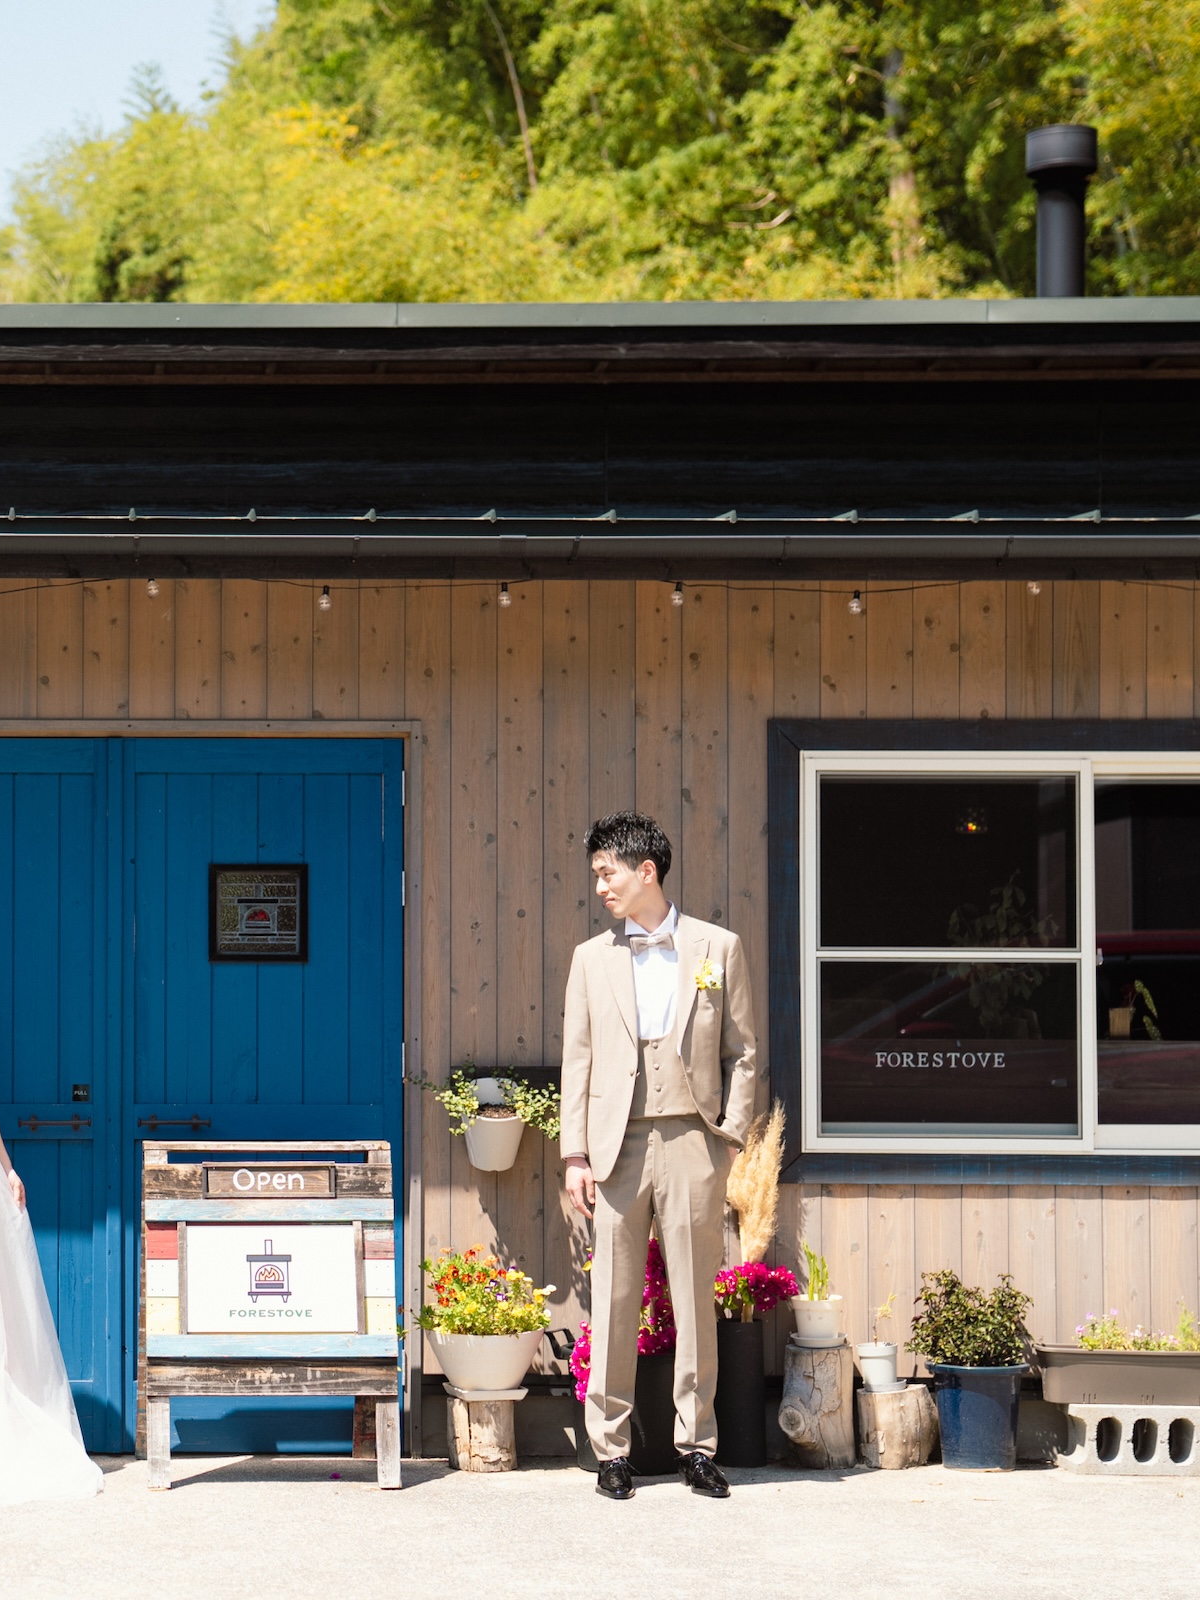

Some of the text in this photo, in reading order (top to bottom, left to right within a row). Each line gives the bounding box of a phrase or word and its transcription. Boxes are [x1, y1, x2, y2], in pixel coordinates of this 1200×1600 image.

[875, 1051, 1006, 1068] FORESTOVE
[232, 1168, 305, 1191] Open
[229, 1309, 313, 1318] FORESTOVE
